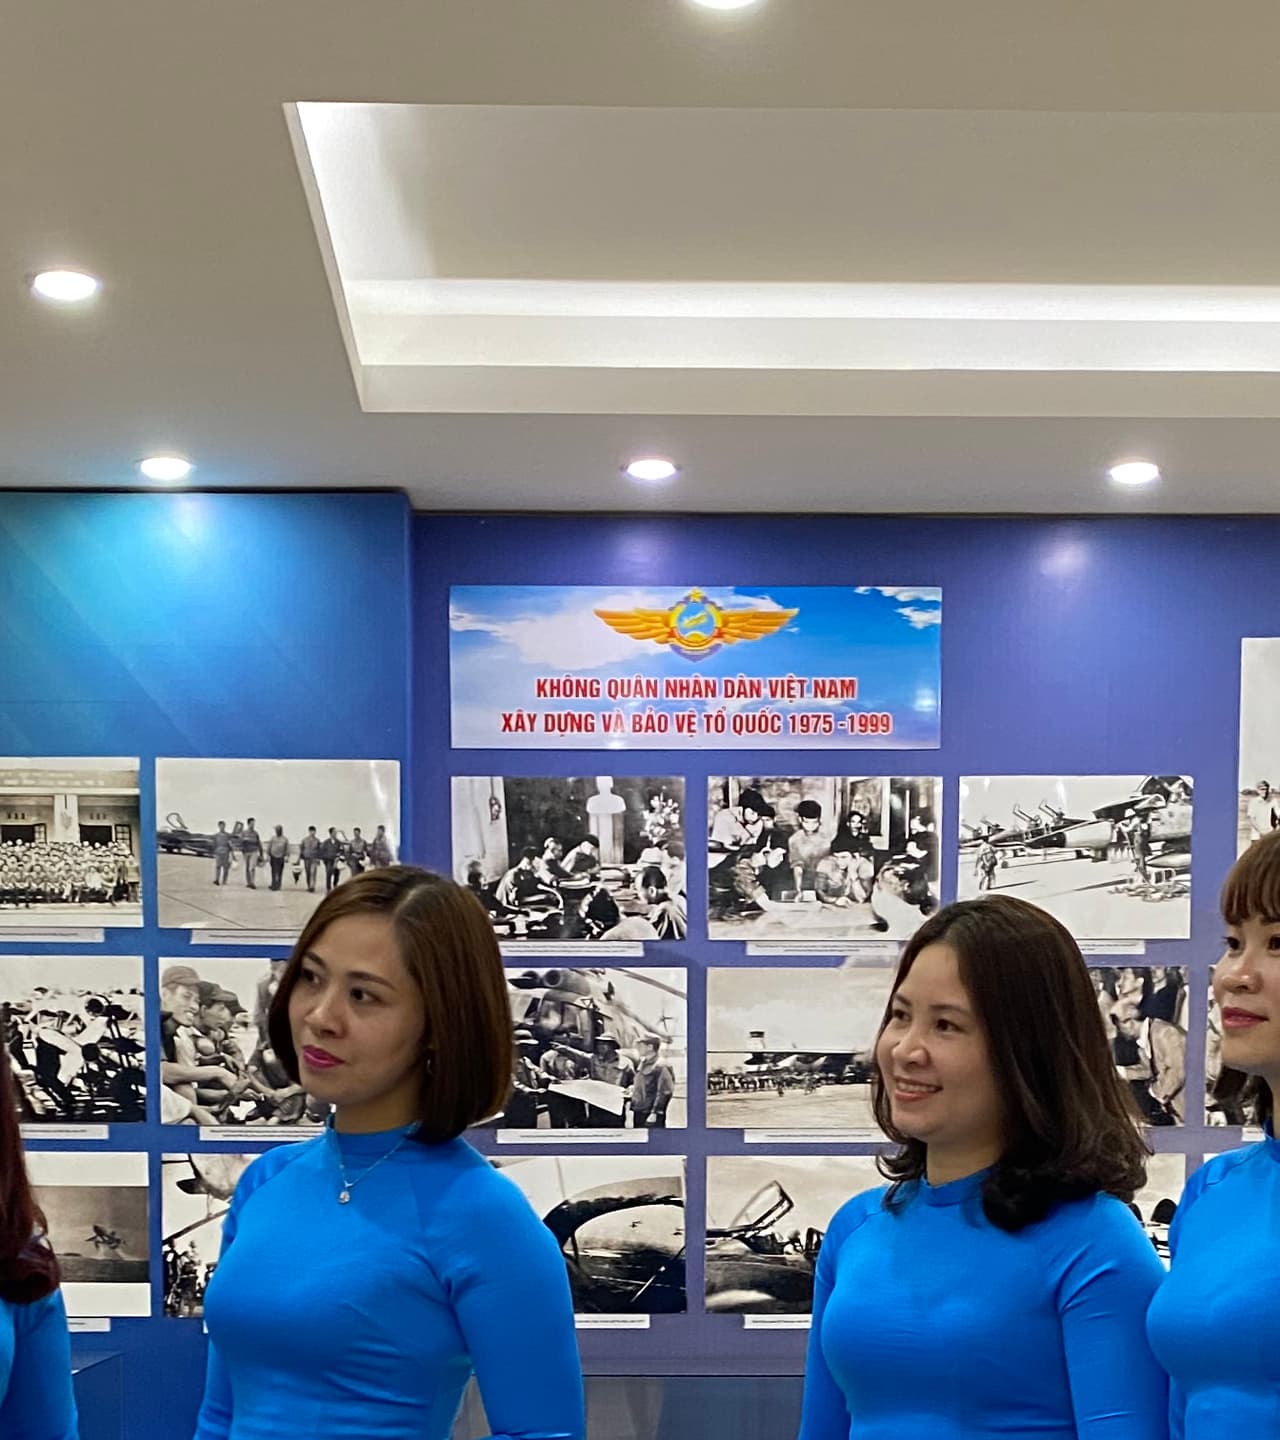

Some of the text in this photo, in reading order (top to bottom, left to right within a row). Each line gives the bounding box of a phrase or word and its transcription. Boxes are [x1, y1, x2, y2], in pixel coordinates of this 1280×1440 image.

[536, 673, 856, 703] KHÔNG QUÂN NHÂN DÂN VIỆT NAM
[501, 708, 537, 733] XÂY
[544, 711, 596, 737] DỰNG
[602, 709, 626, 733] VÀ
[631, 706, 669, 733] BẢO
[675, 709, 697, 738] VỆ
[703, 706, 726, 733] TỔ
[732, 707, 782, 735] QUỐC
[788, 713, 833, 734] 1975
